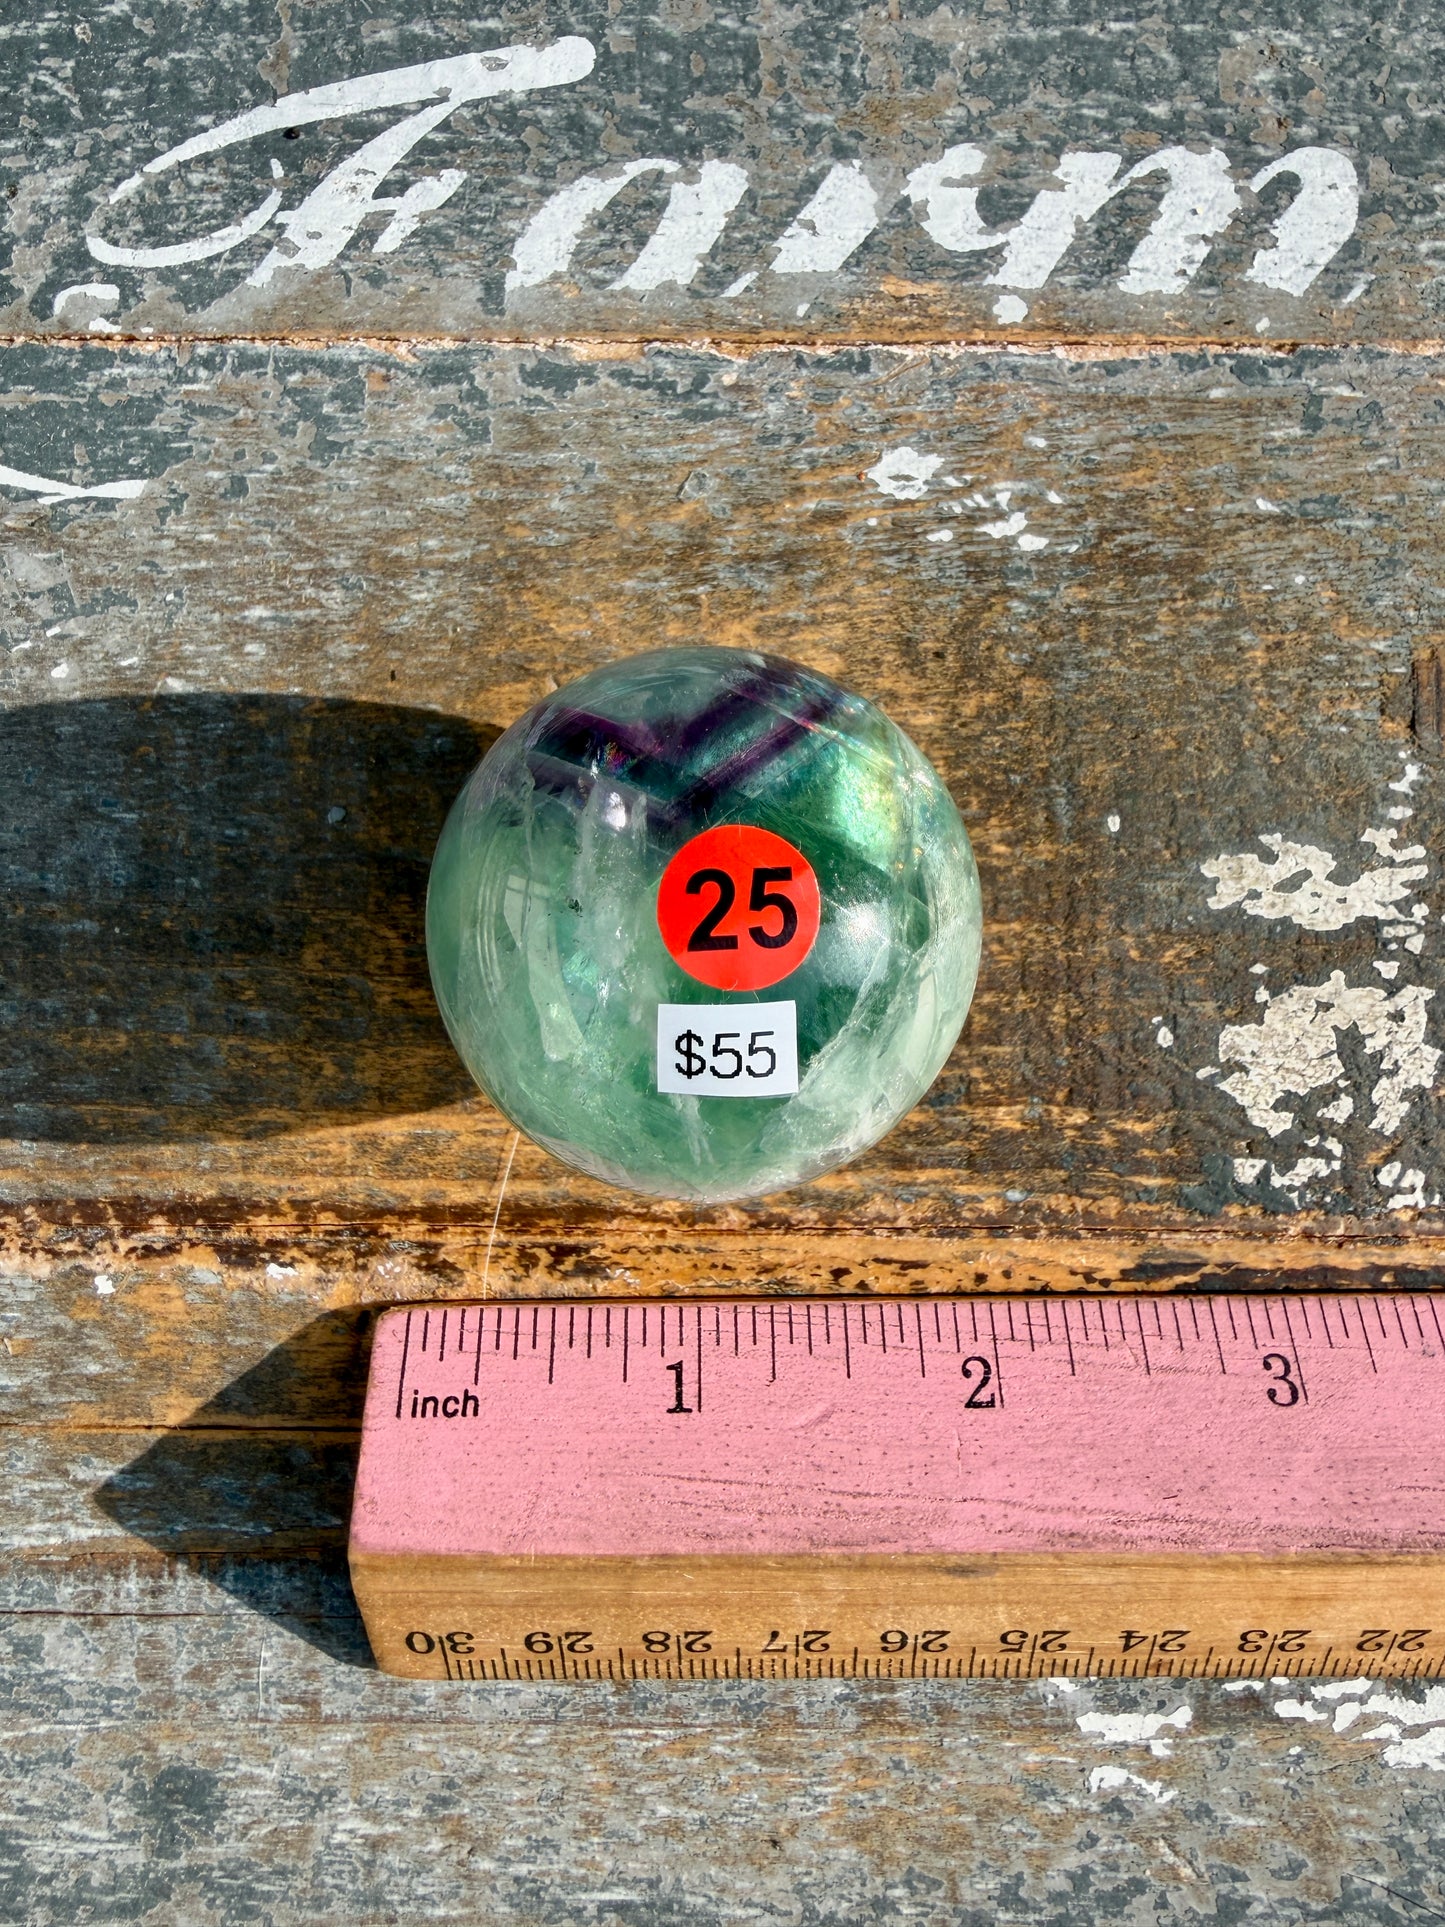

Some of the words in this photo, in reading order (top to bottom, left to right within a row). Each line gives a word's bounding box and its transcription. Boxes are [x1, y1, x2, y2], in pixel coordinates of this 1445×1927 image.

[685, 867, 798, 952] 25
[675, 1029, 776, 1079] $55
[410, 1388, 480, 1419] inch
[666, 1360, 693, 1413] 1
[962, 1356, 996, 1409] 2
[1262, 1353, 1299, 1406] 3
[405, 1631, 475, 1654] 30
[524, 1631, 594, 1654] 29
[641, 1630, 713, 1653] 28
[762, 1630, 831, 1653] 27
[880, 1630, 951, 1653] 26
[1000, 1630, 1071, 1653] 25
[1118, 1629, 1191, 1653] 24
[1238, 1629, 1312, 1653] 23
[1356, 1629, 1432, 1653] 22
